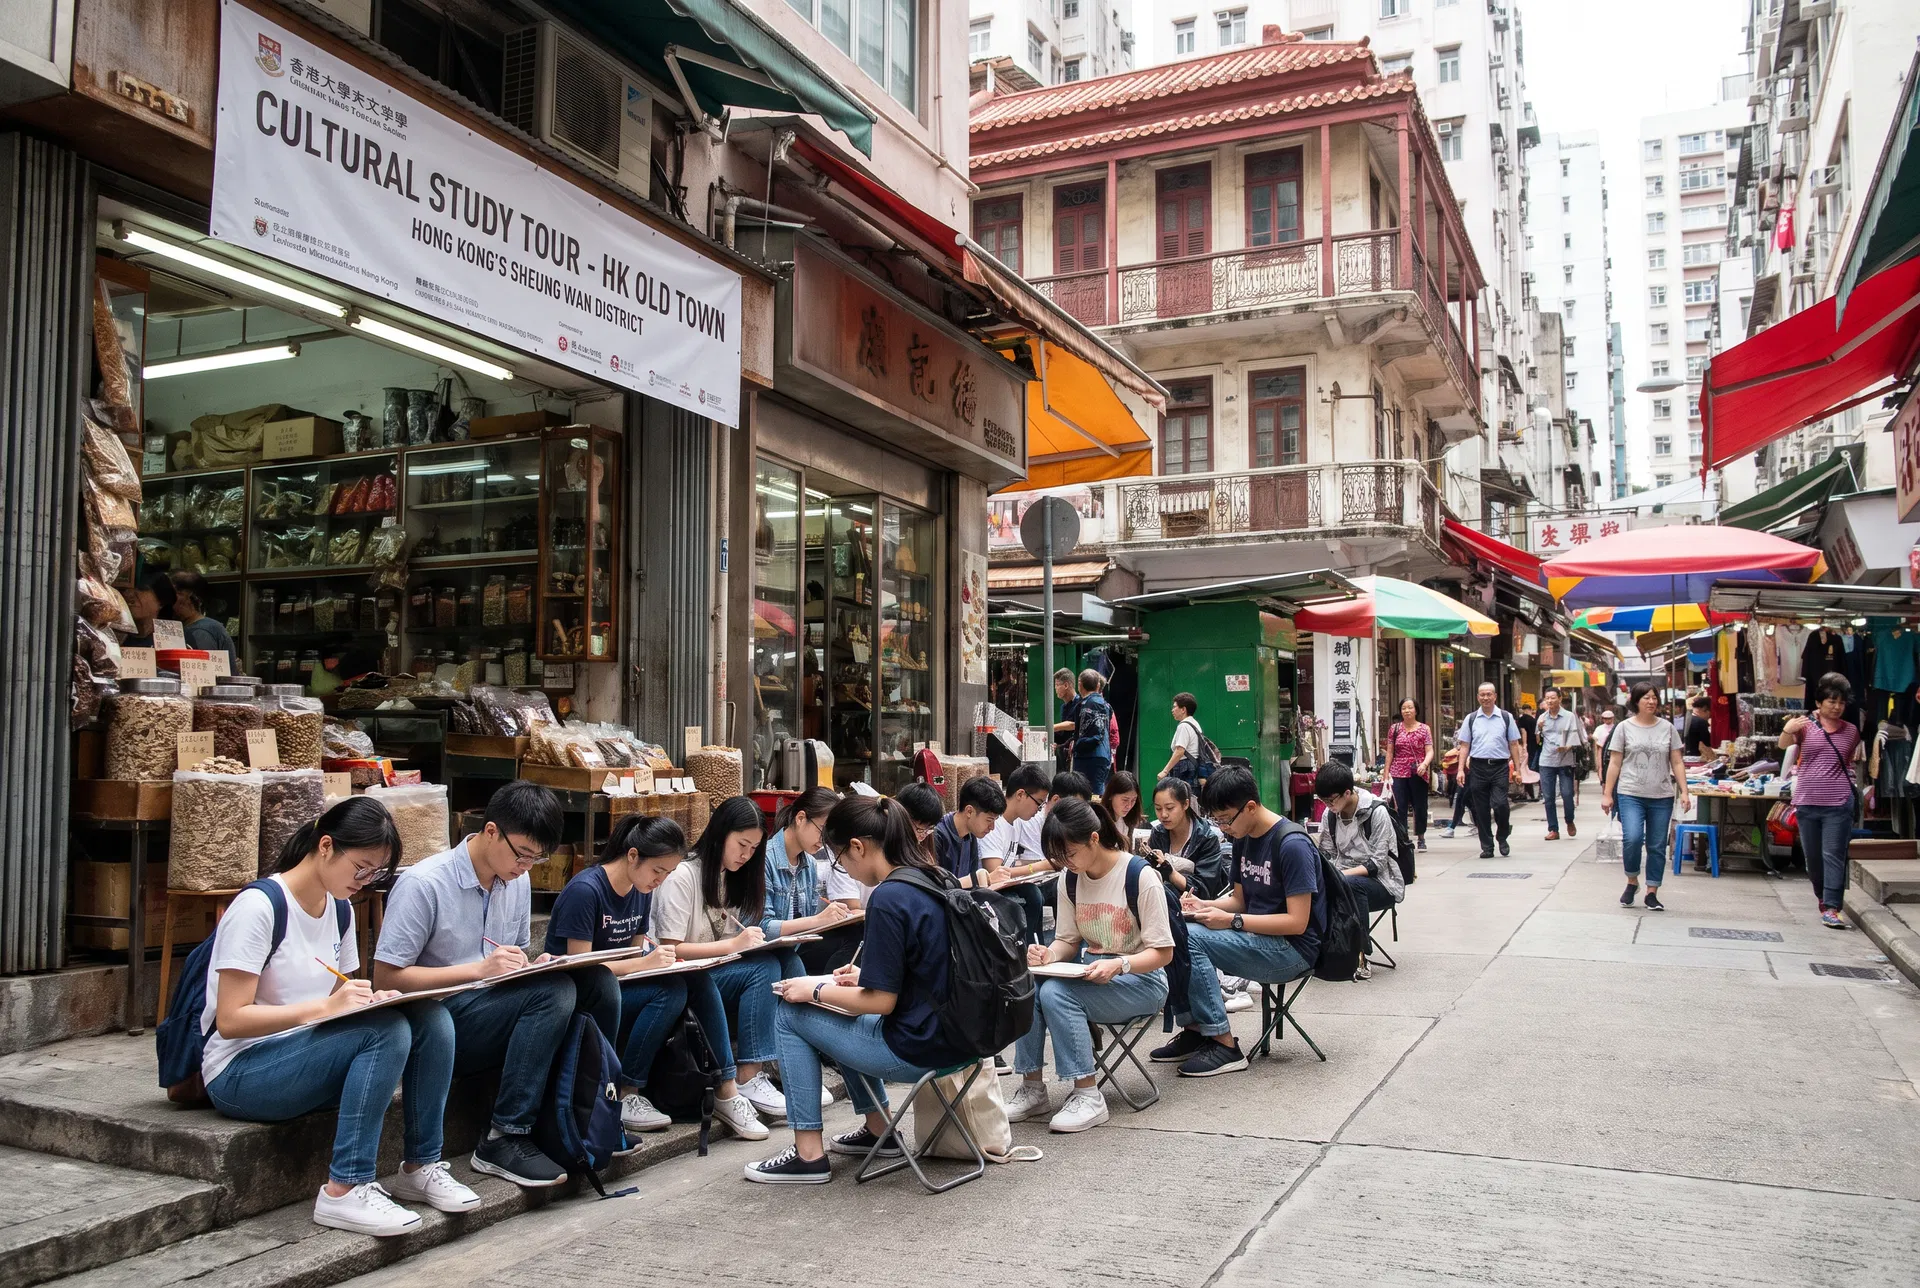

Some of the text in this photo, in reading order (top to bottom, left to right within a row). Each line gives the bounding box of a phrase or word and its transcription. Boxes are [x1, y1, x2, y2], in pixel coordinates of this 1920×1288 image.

[256, 89, 420, 204] CULTURAL
[428, 171, 514, 244] STUDY
[520, 212, 581, 276] TOUR
[602, 253, 630, 299] HK
[635, 271, 671, 316] OLD
[675, 289, 725, 343] TOWN
[411, 217, 453, 254] HONG
[457, 237, 508, 277] KONG'S
[510, 260, 561, 301] SHEUNG
[563, 283, 593, 314] WAN
[595, 297, 644, 336] DISTRICT
